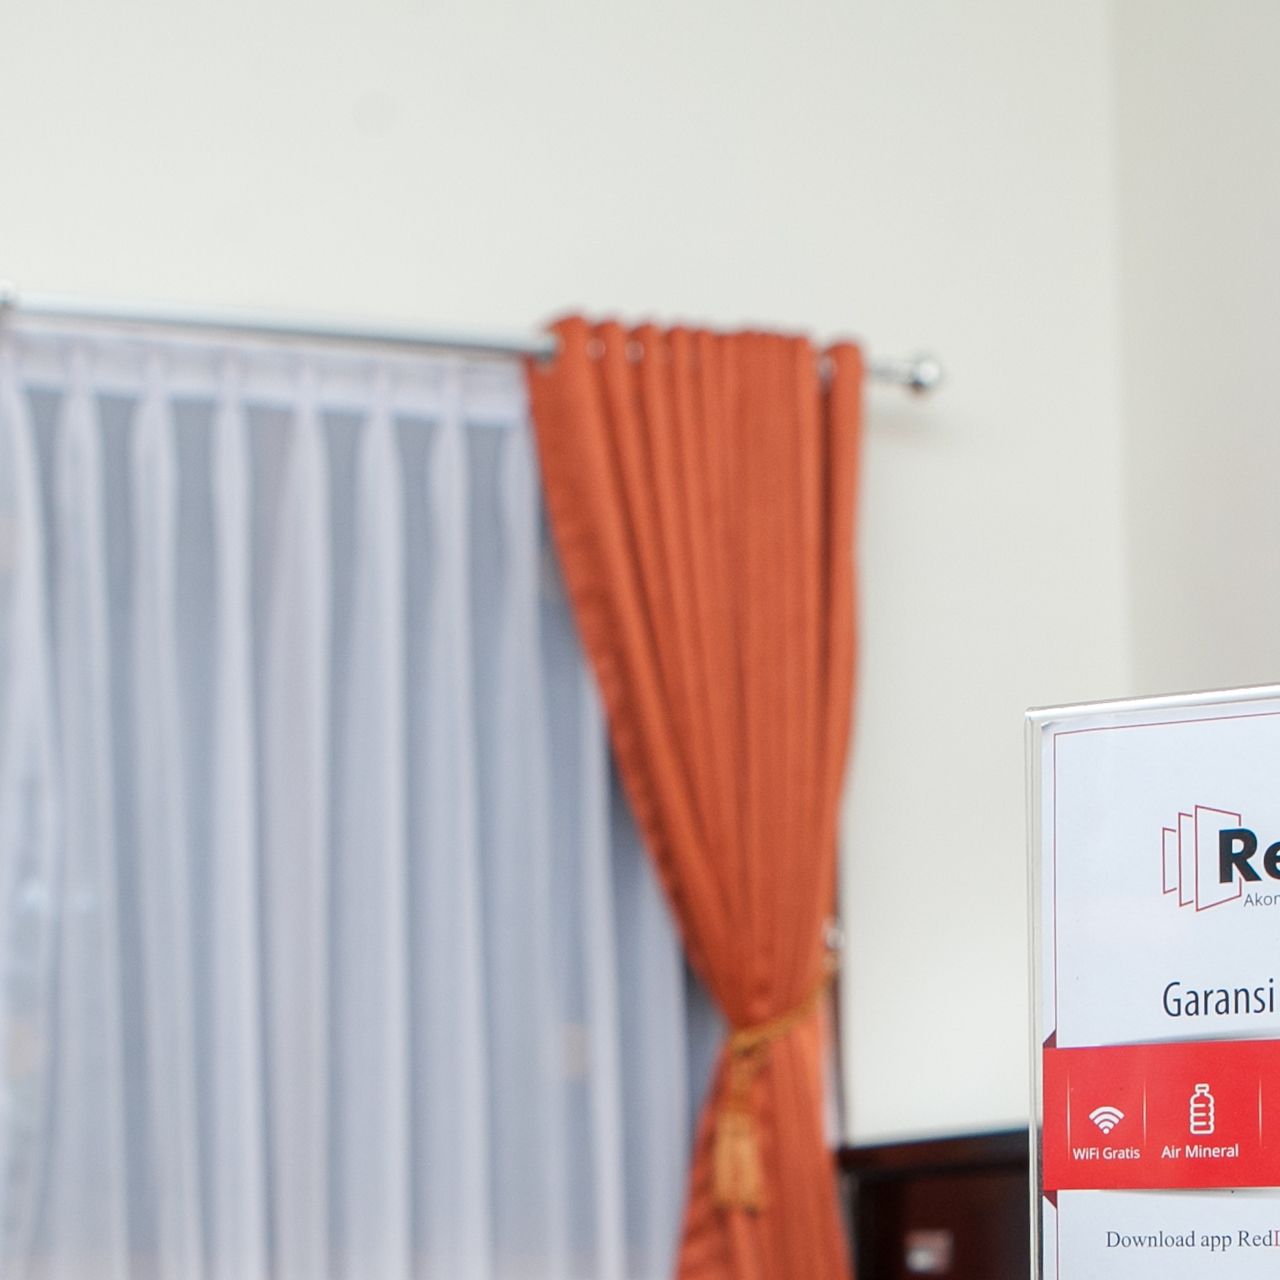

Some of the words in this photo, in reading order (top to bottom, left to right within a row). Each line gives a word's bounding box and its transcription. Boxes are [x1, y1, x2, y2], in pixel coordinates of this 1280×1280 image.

[1162, 977, 1275, 1017] Garansi
[1072, 1148, 1100, 1161] WiFi
[1102, 1146, 1141, 1160] Gratis
[1161, 1145, 1182, 1159] Air
[1185, 1143, 1239, 1159] Mineral
[1105, 1230, 1196, 1250] Download
[1200, 1233, 1233, 1255] app
